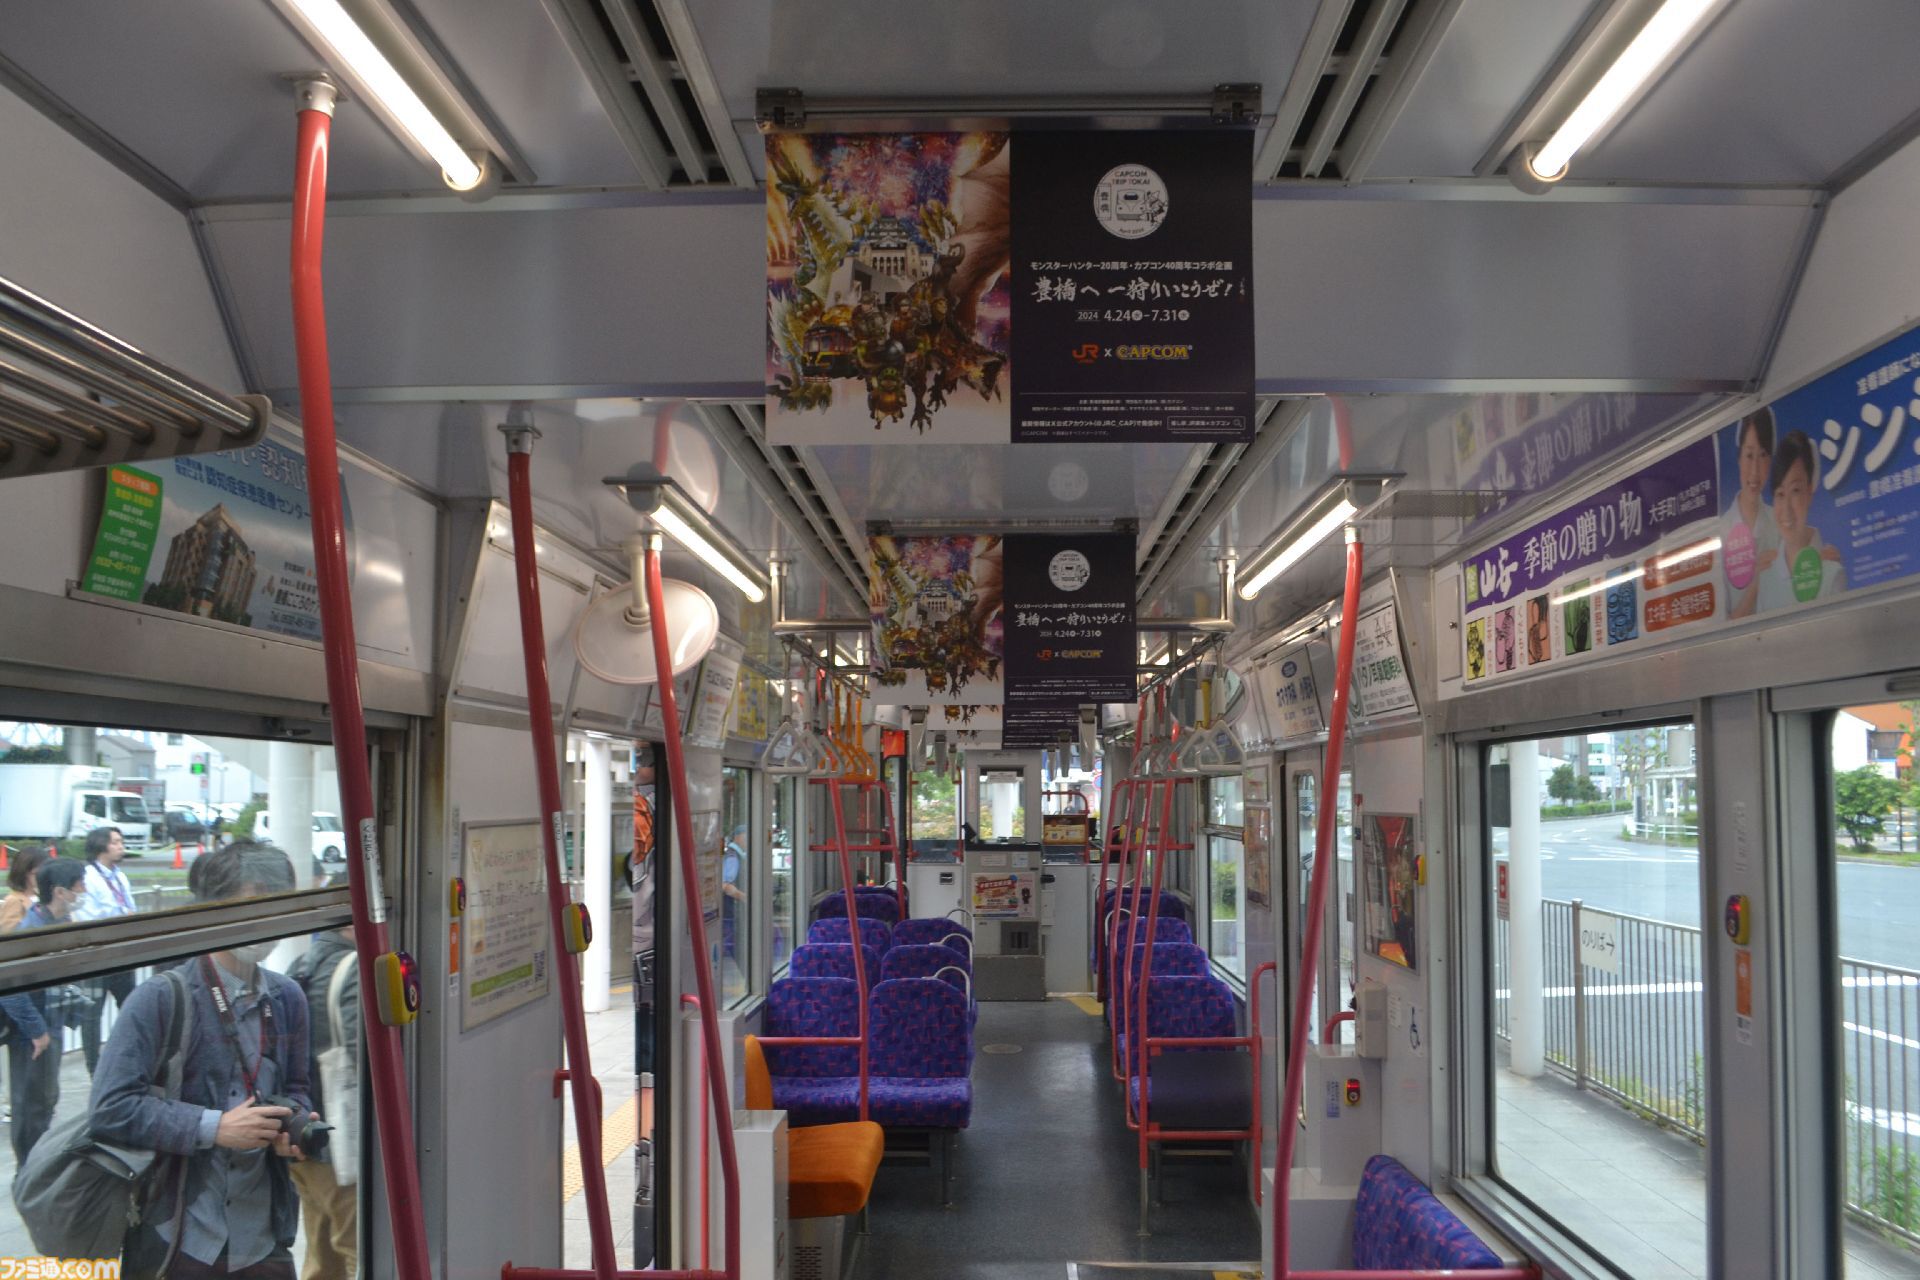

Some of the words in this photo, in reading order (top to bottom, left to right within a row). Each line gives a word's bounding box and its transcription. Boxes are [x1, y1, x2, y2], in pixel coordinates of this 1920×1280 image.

[1078, 311, 1098, 320] 2024
[1071, 343, 1100, 359] JR
[1115, 344, 1189, 360] CAPCOM
[1523, 491, 1642, 579] 季節の贈り物
[1648, 496, 1676, 525] 大手町
[1582, 929, 1605, 951] のりば
[211, 985, 228, 1013] PENTAX
